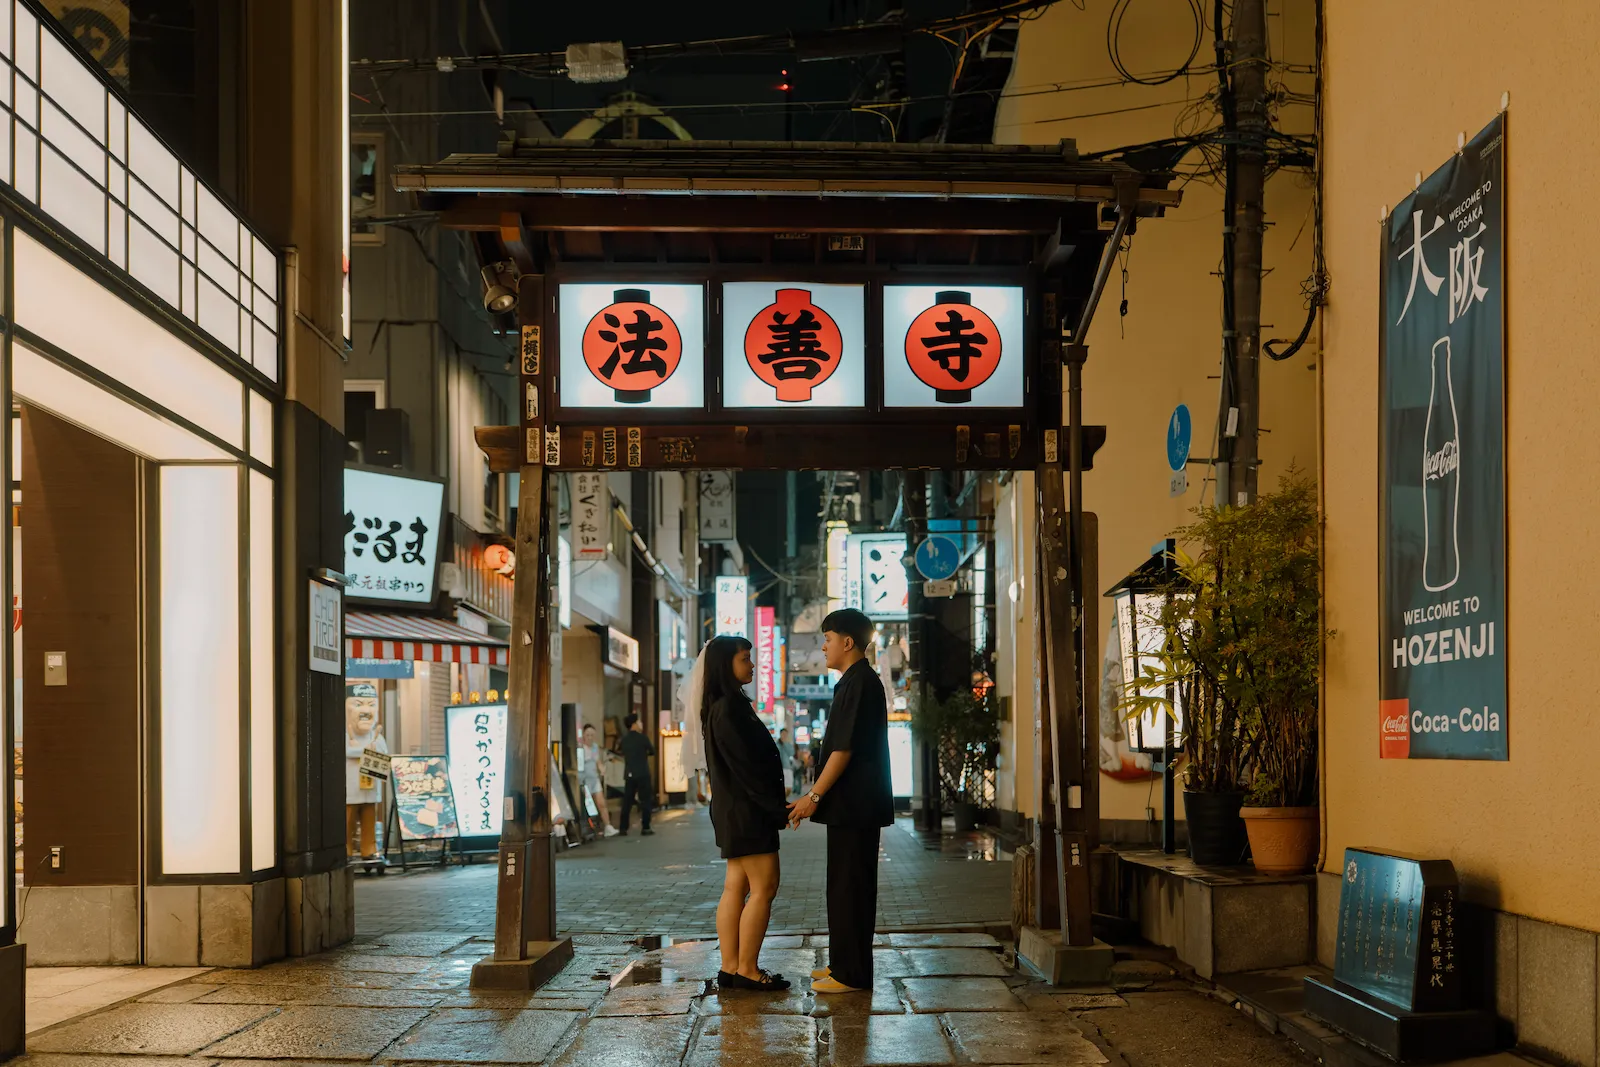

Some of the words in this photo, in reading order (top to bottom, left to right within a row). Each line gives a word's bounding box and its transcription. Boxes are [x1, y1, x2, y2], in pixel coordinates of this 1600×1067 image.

[1448, 188, 1481, 222] WELCOME
[1482, 180, 1492, 196] TO
[1457, 205, 1484, 233] OSAKA
[1396, 209, 1489, 326] 大阪
[598, 309, 668, 380] 法
[757, 310, 831, 381] 善
[920, 310, 988, 382] 寺
[1404, 600, 1460, 626] WELCOME
[1463, 596, 1480, 614] TO
[1393, 622, 1495, 668] HOZENJI
[1411, 705, 1500, 733] Coca-Cola
